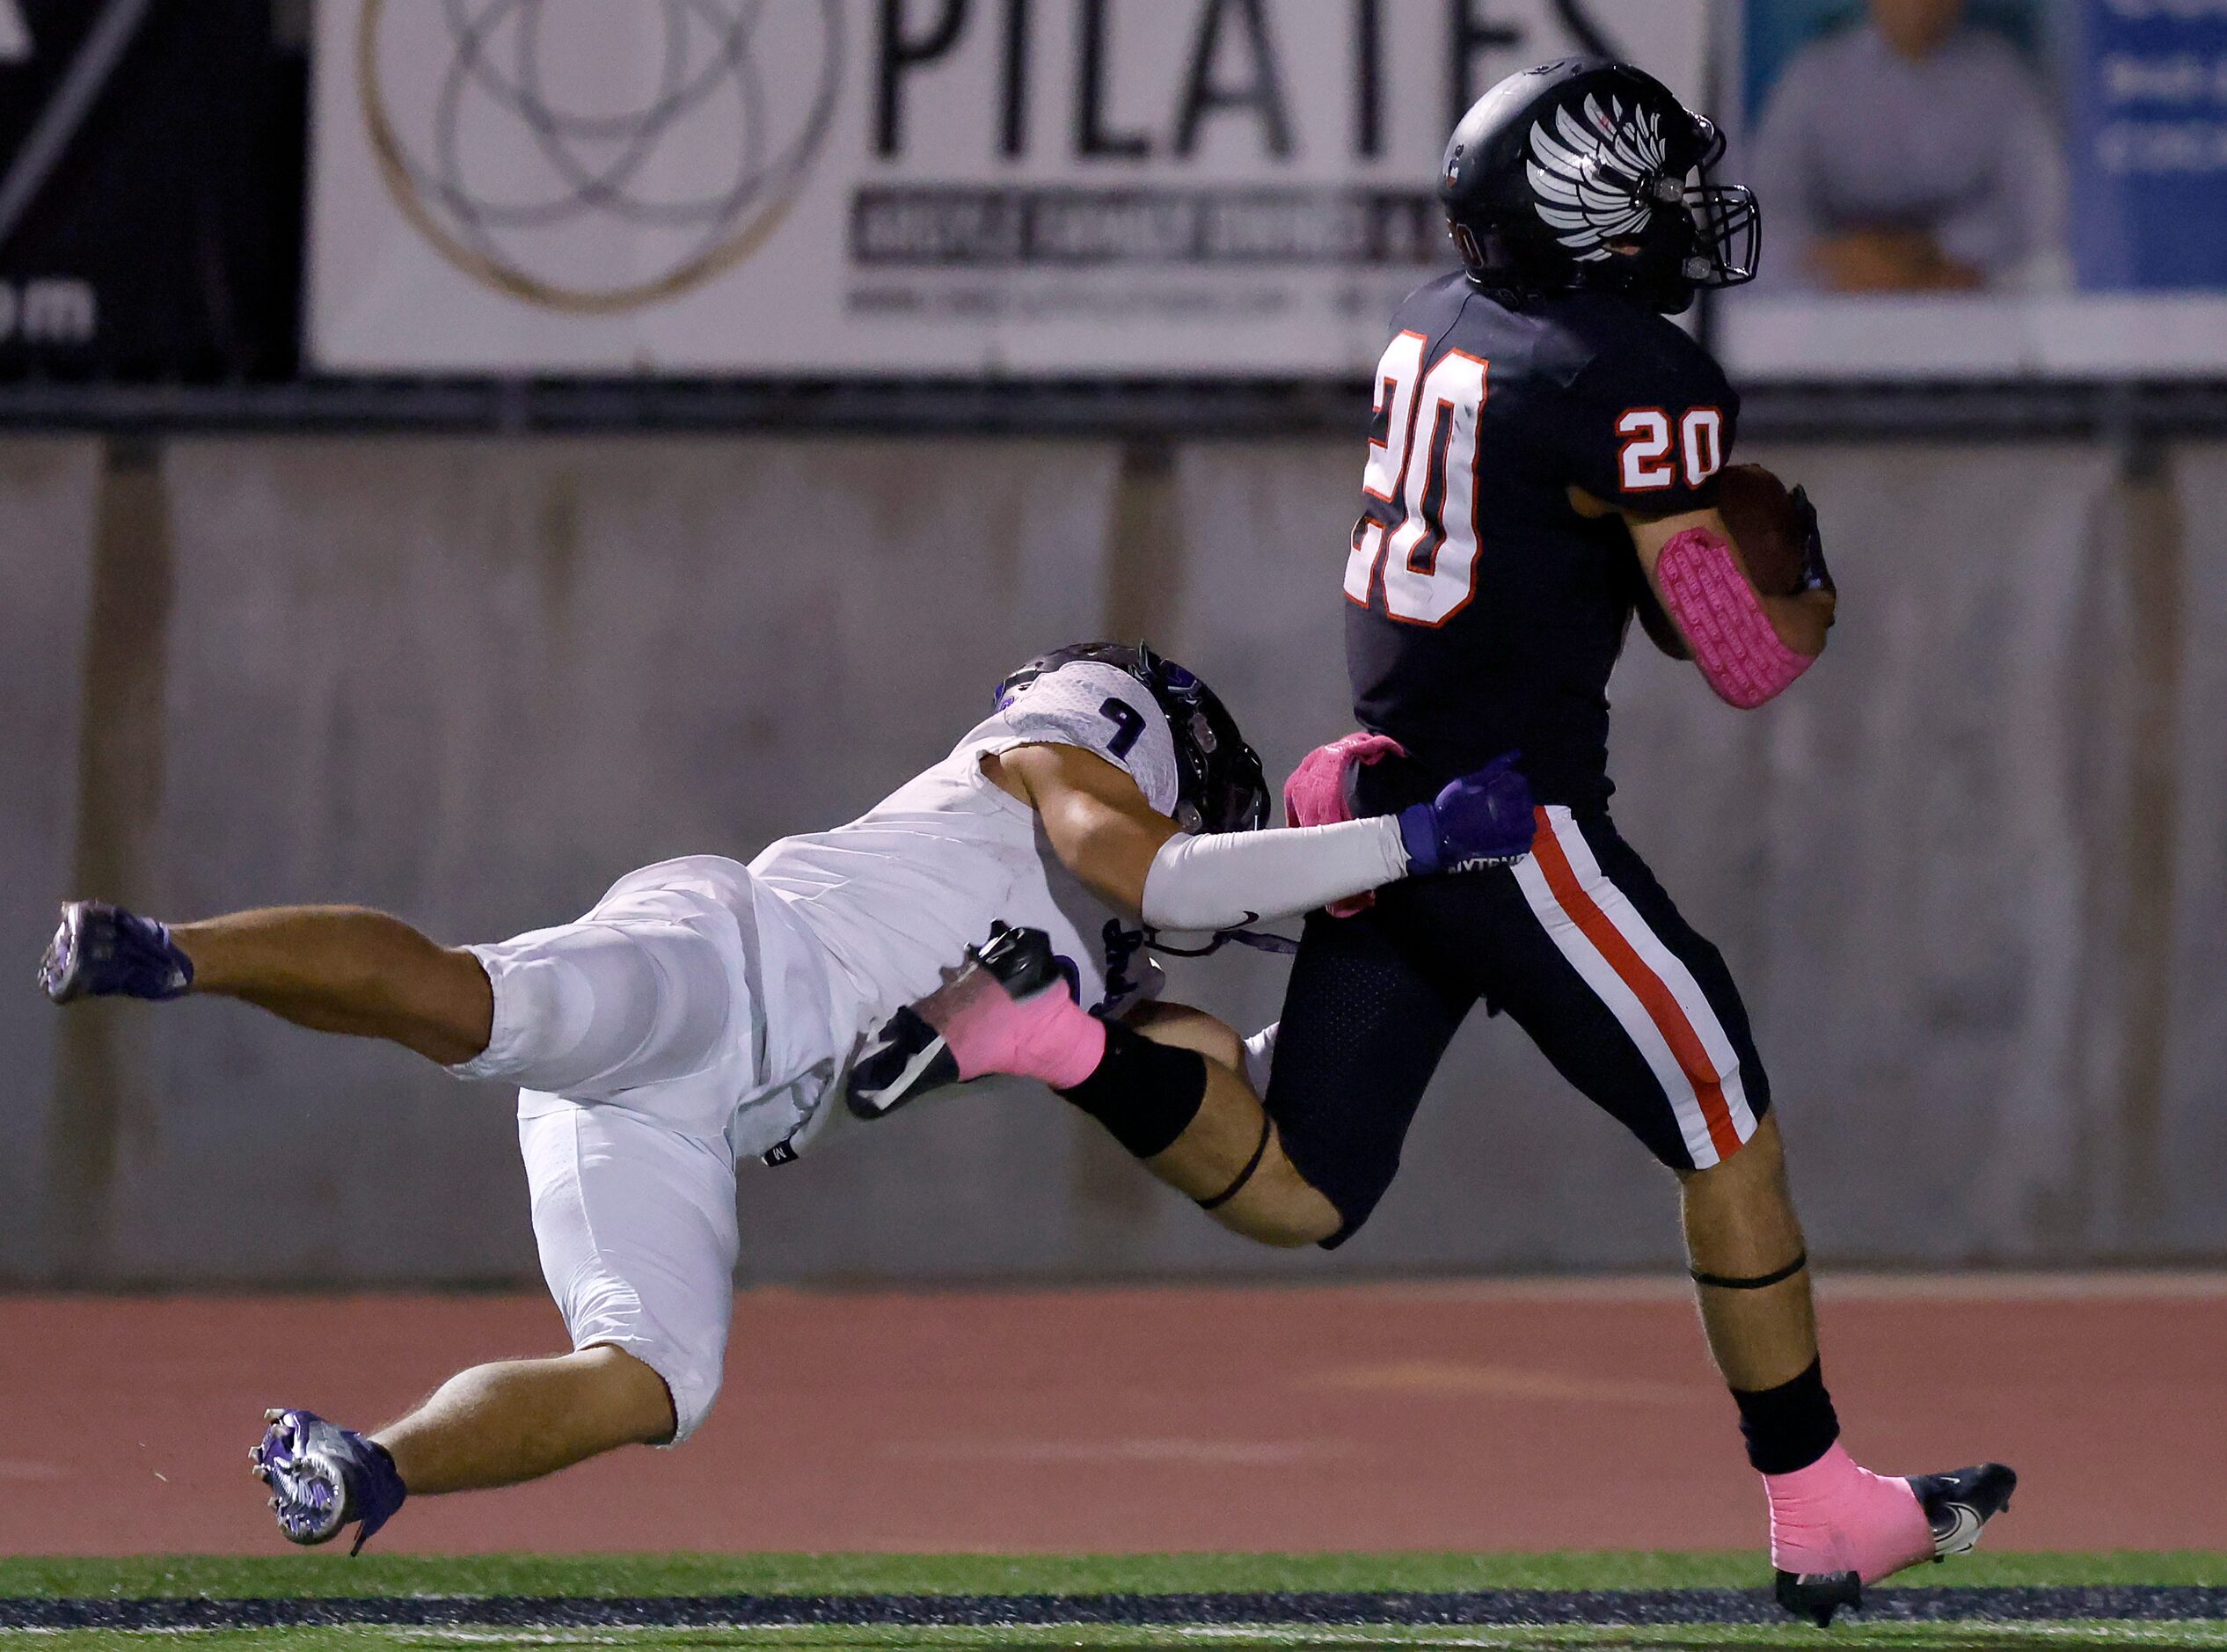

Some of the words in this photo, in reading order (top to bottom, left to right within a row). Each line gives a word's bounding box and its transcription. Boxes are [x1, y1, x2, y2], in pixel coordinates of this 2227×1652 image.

[871, 0, 1617, 160] PILAT
[1343, 328, 1489, 629] 20
[1614, 406, 1723, 493] 20
[1099, 697, 1146, 760] 9
